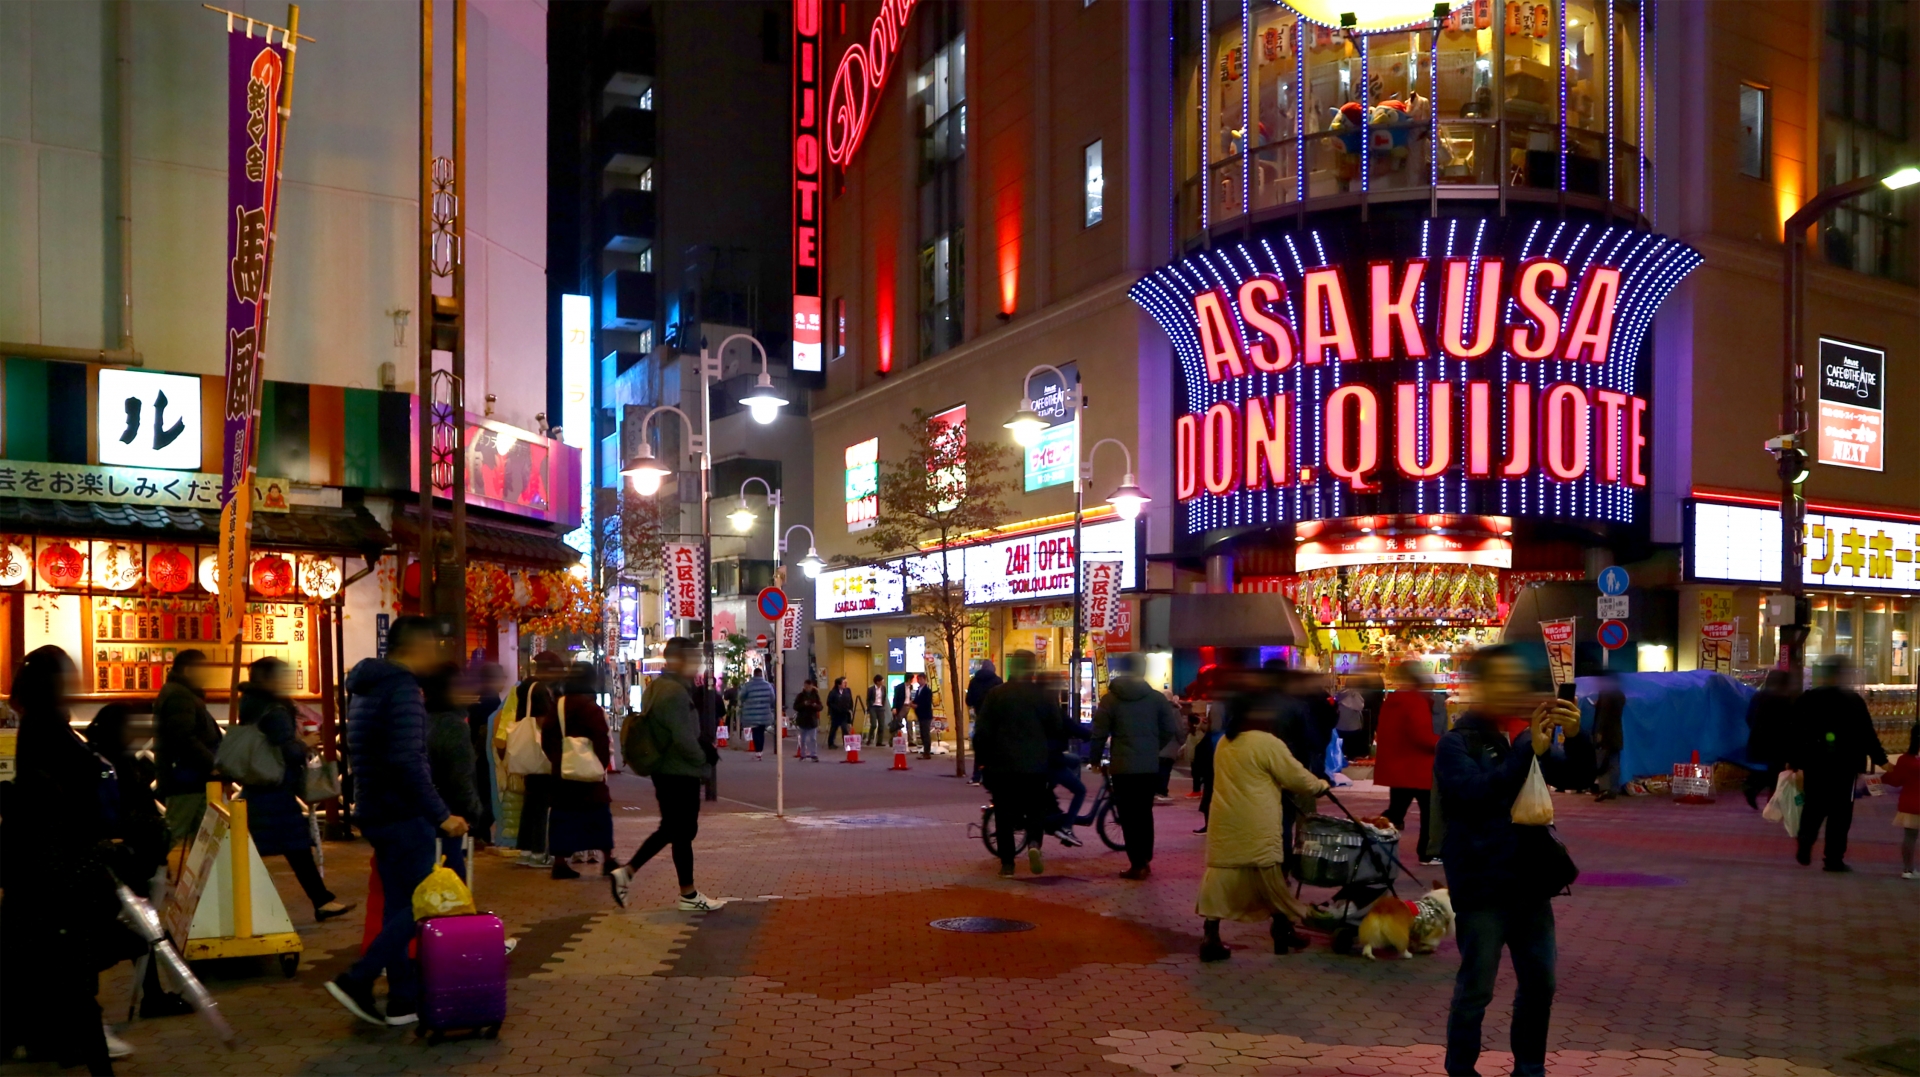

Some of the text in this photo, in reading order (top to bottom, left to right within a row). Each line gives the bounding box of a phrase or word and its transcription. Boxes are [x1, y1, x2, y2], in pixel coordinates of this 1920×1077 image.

[1194, 258, 1622, 383] ASAKUSA
[119, 390, 184, 450] ル
[1832, 439, 1870, 463] NEXT
[675, 547, 696, 618] 六区花道
[1005, 537, 1075, 576] 24H OPEN
[1089, 564, 1111, 628] 六区花道
